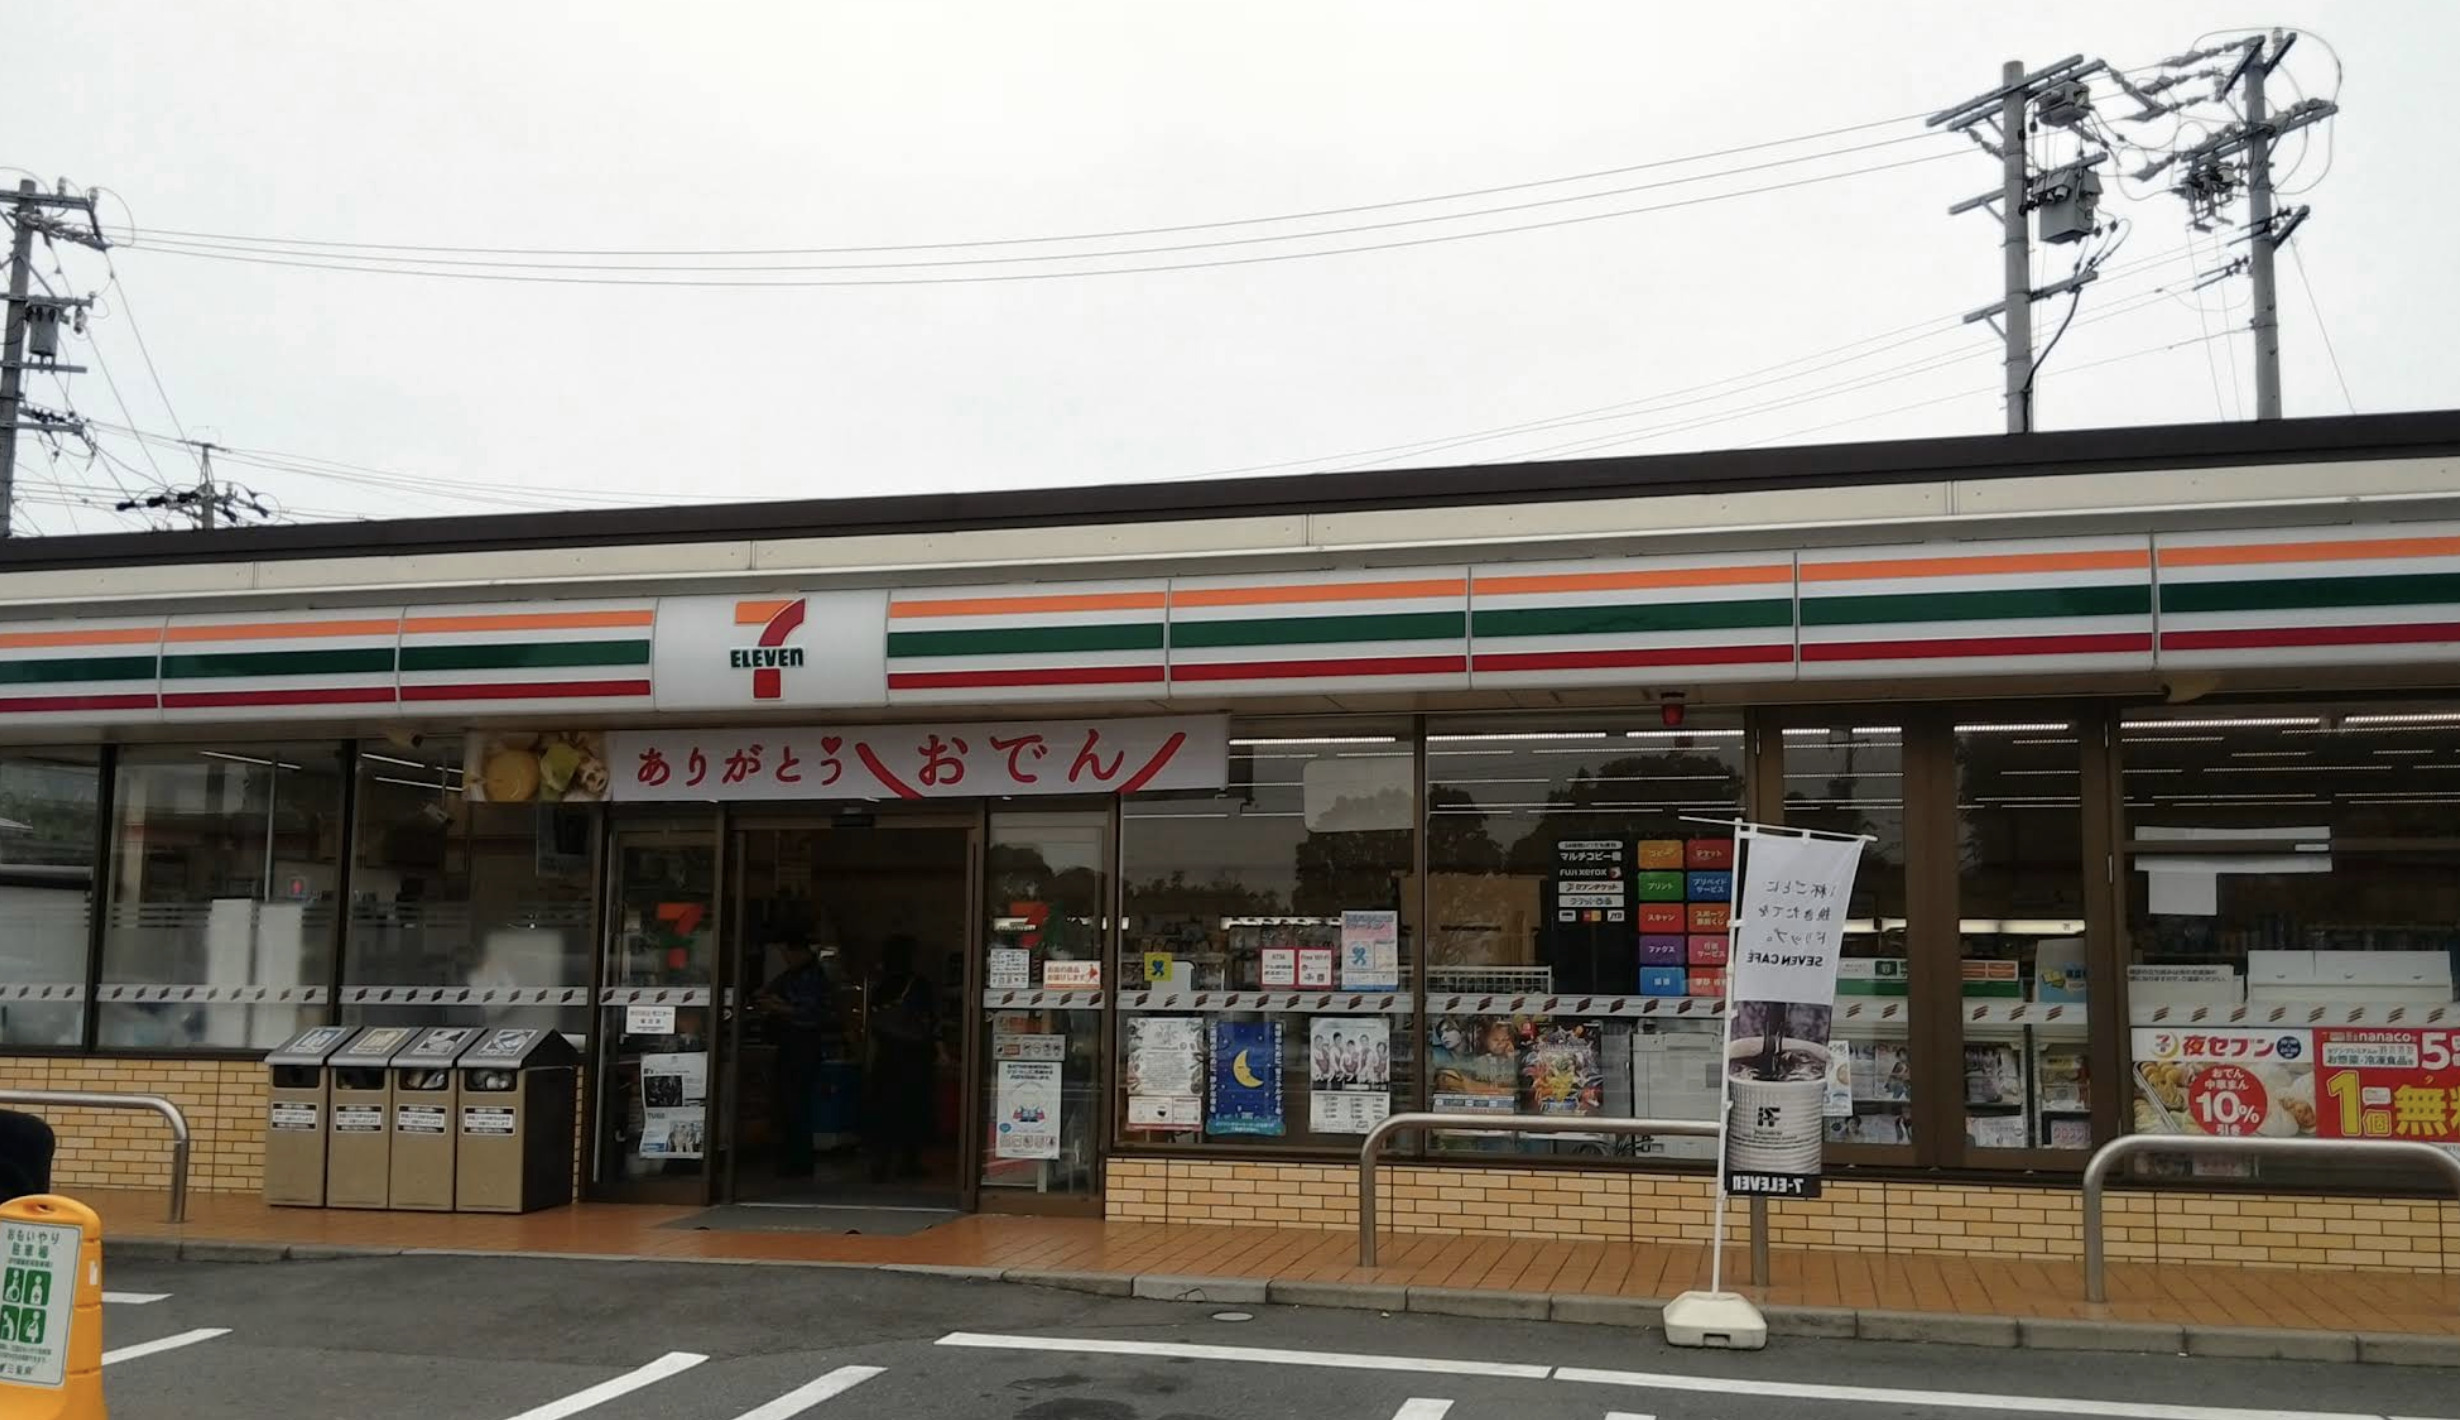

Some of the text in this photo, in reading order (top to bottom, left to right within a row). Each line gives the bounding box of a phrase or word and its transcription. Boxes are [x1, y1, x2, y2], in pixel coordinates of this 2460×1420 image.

[636, 728, 1125, 788] ありがとう おでん
[1560, 851, 1622, 862] マルチコピー機
[1647, 881, 1674, 891] プリント
[1692, 878, 1727, 886] プリペイド
[1695, 885, 1725, 893] サービス
[1647, 913, 1676, 922] スキャン
[1695, 910, 1726, 918] スポーツ
[1648, 945, 1675, 953] ファクス
[1696, 950, 1726, 958] サービス
[2358, 1033, 2412, 1042] nanaco
[2182, 1034, 2275, 1057] 夜セブン
[2212, 1067, 2245, 1079] おでん
[2204, 1079, 2250, 1091] 中華まん
[2195, 1090, 2260, 1124] 10%
[8, 1228, 59, 1246] おもいやり
